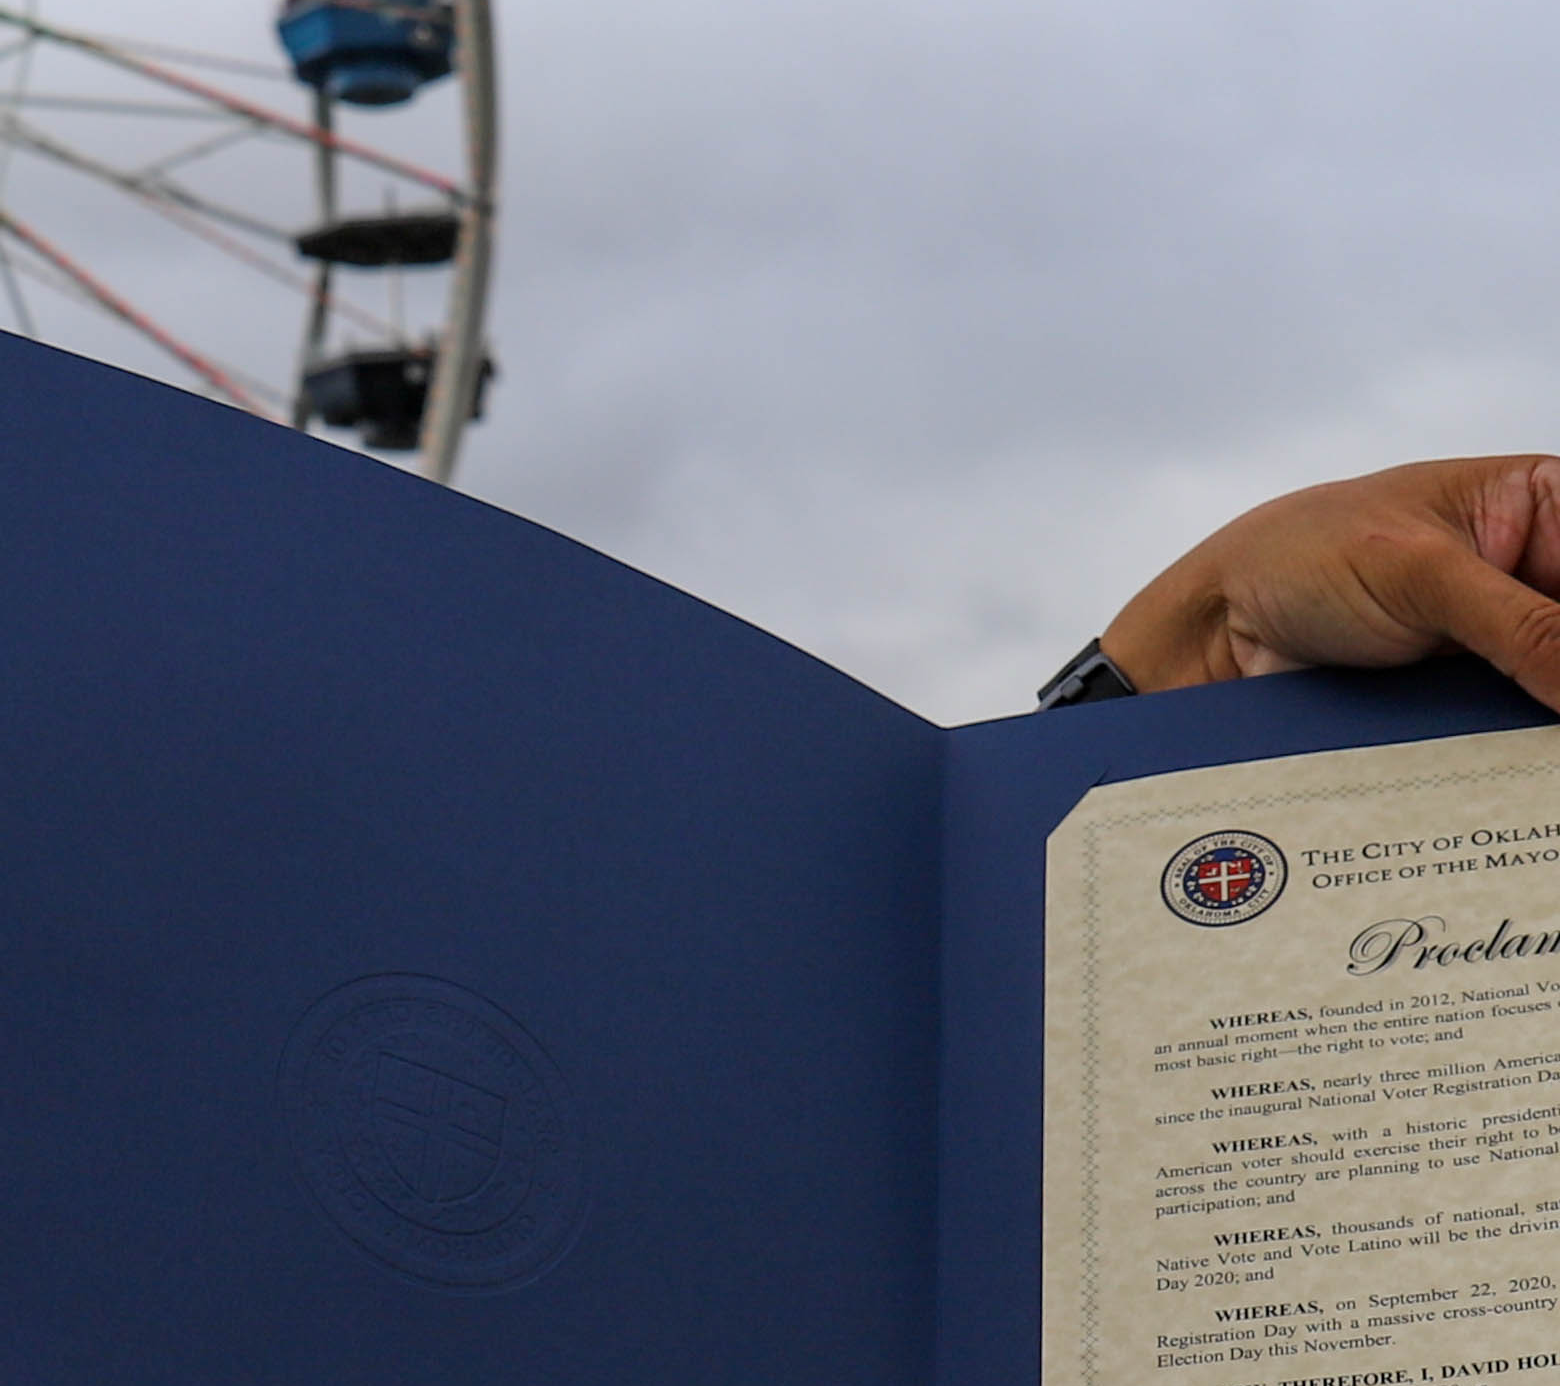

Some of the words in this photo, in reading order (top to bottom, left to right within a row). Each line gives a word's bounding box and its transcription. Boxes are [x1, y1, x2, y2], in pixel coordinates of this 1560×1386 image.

[1174, 855, 1191, 879] SEAL
[1193, 845, 1207, 856] OF
[1213, 839, 1236, 848] THE
[1240, 840, 1265, 855] CITY
[1263, 853, 1274, 867] OF
[1178, 897, 1240, 918] OKLAHOMA
[1247, 888, 1270, 908] CITY
[1209, 1008, 1313, 1030] WHEREAS,
[1319, 1000, 1383, 1018] founded
[1389, 1001, 1405, 1011] in
[1410, 993, 1456, 1009] 2012,
[1461, 983, 1530, 1004] National
[1154, 1058, 1191, 1073] most
[1196, 1054, 1236, 1068] basic
[1241, 1042, 1322, 1063] right—the
[1326, 1037, 1364, 1054] right
[1369, 1038, 1385, 1048] to
[1389, 1033, 1429, 1046] vote;
[1434, 1027, 1464, 1042] and
[1213, 1224, 1321, 1247] WHEREAS,
[1331, 1215, 1415, 1235] thousands
[1424, 1211, 1444, 1226] of
[1453, 1202, 1526, 1223] national,
[1214, 1300, 1324, 1323] WHEREAS,
[1335, 1300, 1357, 1311] on
[1368, 1288, 1459, 1310] September
[1470, 1282, 1497, 1298] 22,
[1508, 1275, 1556, 1293] 2020,
[1157, 1329, 1255, 1350] Registration
[1264, 1324, 1297, 1339] Day
[1305, 1317, 1342, 1333] with
[1350, 1319, 1360, 1329] a
[1367, 1311, 1436, 1328] massive
[1442, 1297, 1558, 1320] cross-country
[1157, 1352, 1224, 1368] Election
[1229, 1347, 1264, 1363] Day
[1268, 1343, 1298, 1357] this
[1303, 1334, 1396, 1354] November.
[1421, 1367, 1434, 1383] I,
[1440, 1359, 1510, 1379] DAVID
